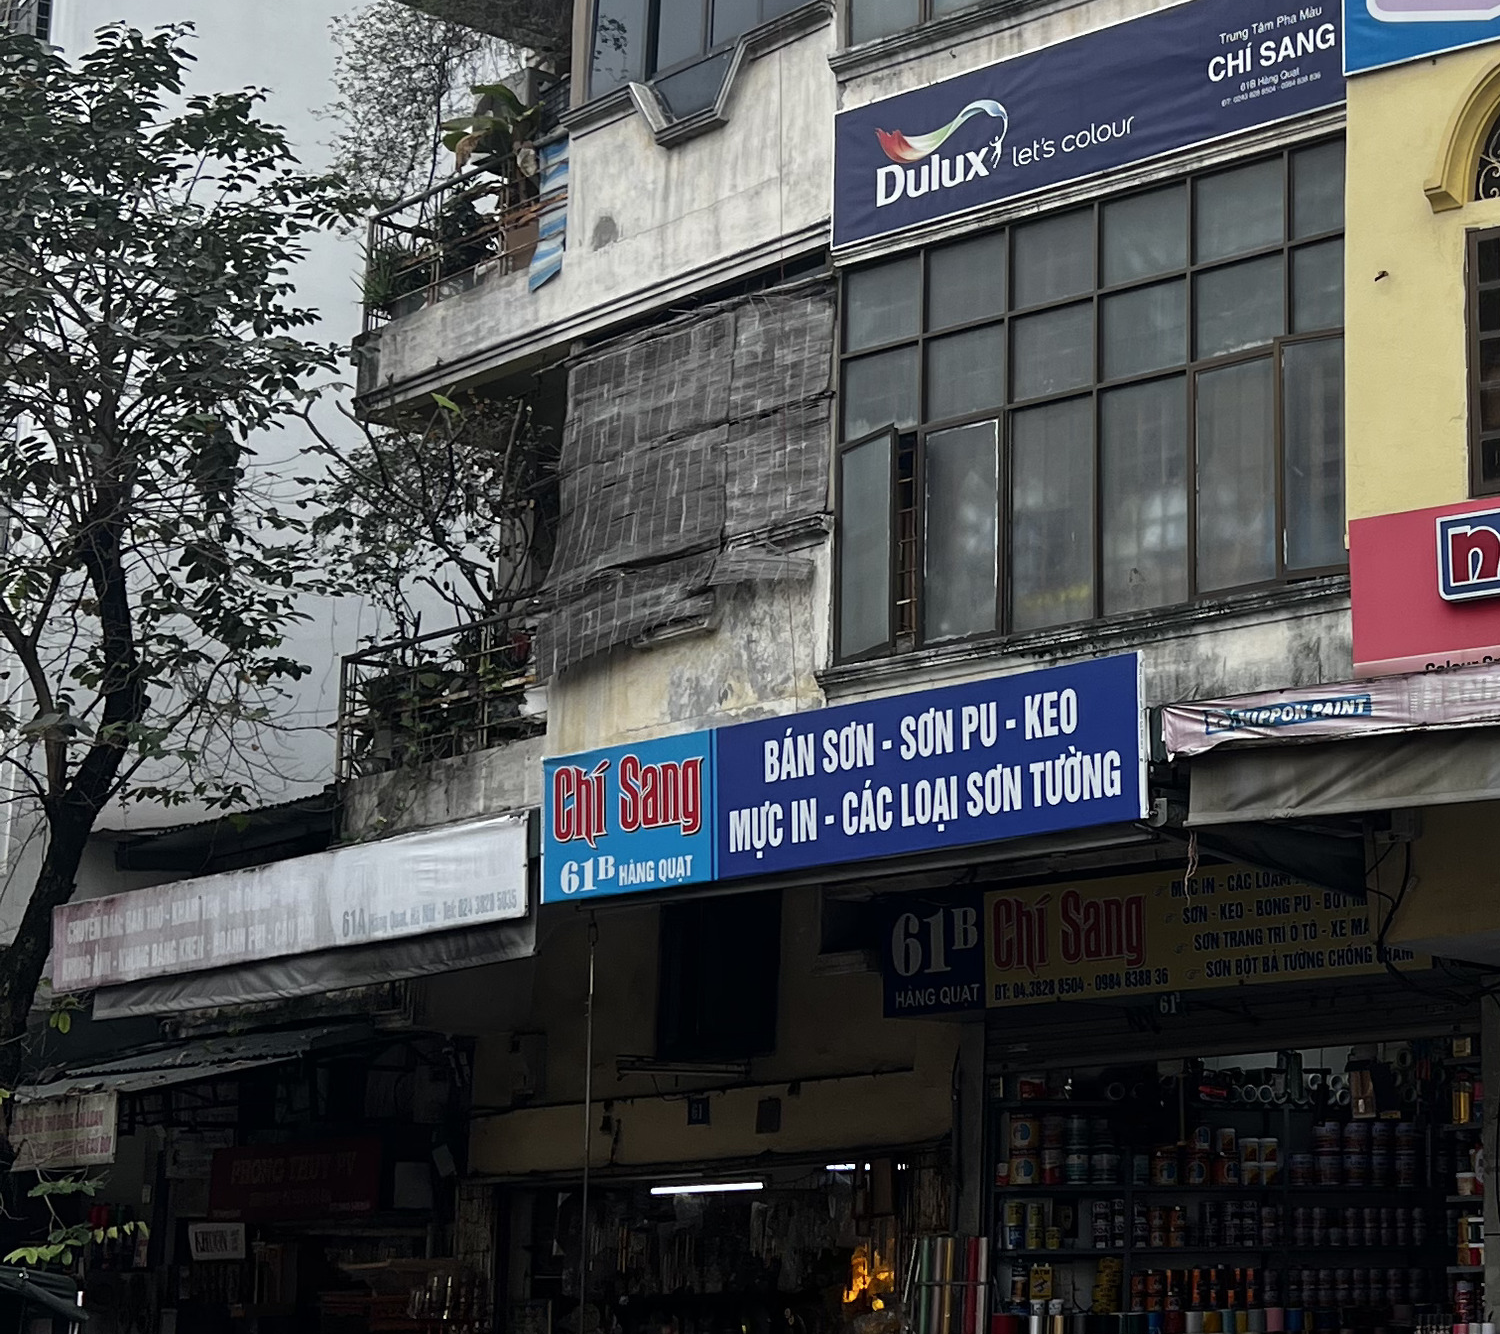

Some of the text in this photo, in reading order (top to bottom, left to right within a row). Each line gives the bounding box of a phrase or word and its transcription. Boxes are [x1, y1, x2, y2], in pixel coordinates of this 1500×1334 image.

[1219, 5, 1323, 45] Trung Tâm Pha Màu
[1207, 22, 1336, 83] CHÍ SANG
[1012, 115, 1137, 168] let's colour
[875, 149, 991, 209] Dulux
[1311, 697, 1368, 720] PAINT
[764, 725, 816, 784] BÁN
[821, 718, 876, 774] SƠN
[900, 705, 955, 761] SƠN
[962, 699, 998, 750] PU
[1024, 686, 1080, 742] KEO
[552, 752, 705, 850] Chí Sang
[728, 804, 785, 860] MỰC
[790, 796, 819, 844] IN
[841, 775, 894, 838] CÁC
[900, 773, 960, 833] LOẠI
[966, 759, 1023, 817] SƠN
[1029, 744, 1123, 805] TƯỜNG
[560, 853, 693, 896] 61B HÀNG QUẠT
[342, 907, 366, 938] 61A
[1182, 894, 1312, 926] SƠN KEO PU
[891, 887, 1148, 978] 61B Chí Sang
[1194, 931, 1220, 952] SƠN
[1223, 928, 1264, 949] TRANG
[1331, 919, 1348, 939] XE
[1155, 967, 1170, 986] 36
[1205, 958, 1232, 979] SƠN
[895, 982, 981, 1010] HÀNG QUẠT
